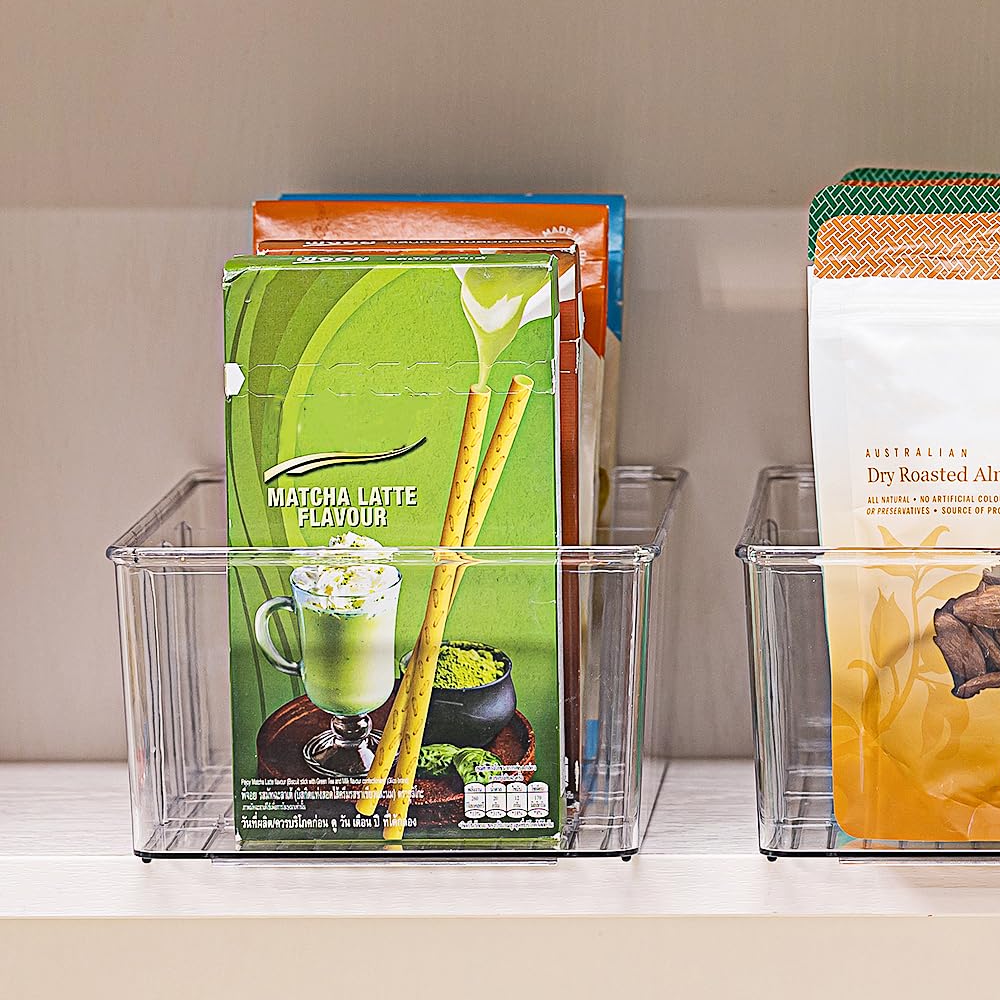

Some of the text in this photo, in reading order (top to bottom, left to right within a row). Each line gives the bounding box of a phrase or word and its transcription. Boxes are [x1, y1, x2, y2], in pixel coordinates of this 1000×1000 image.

[542, 225, 575, 237] MADE
[866, 447, 968, 458] AUSTRALIAN
[867, 467, 895, 486] Dry
[899, 466, 968, 482] Roasted
[267, 486, 418, 508] MATCHA LATTE
[867, 496, 880, 504] ALL
[882, 496, 910, 504] NATURAL
[920, 495, 930, 504] NO
[932, 495, 975, 503] ARTIFICIAL
[866, 507, 876, 515] OR
[877, 506, 930, 515] PRESERVATIVES
[942, 506, 972, 515] SOURCE
[975, 506, 985, 514] OF
[298, 507, 388, 528] FLAVOUR
